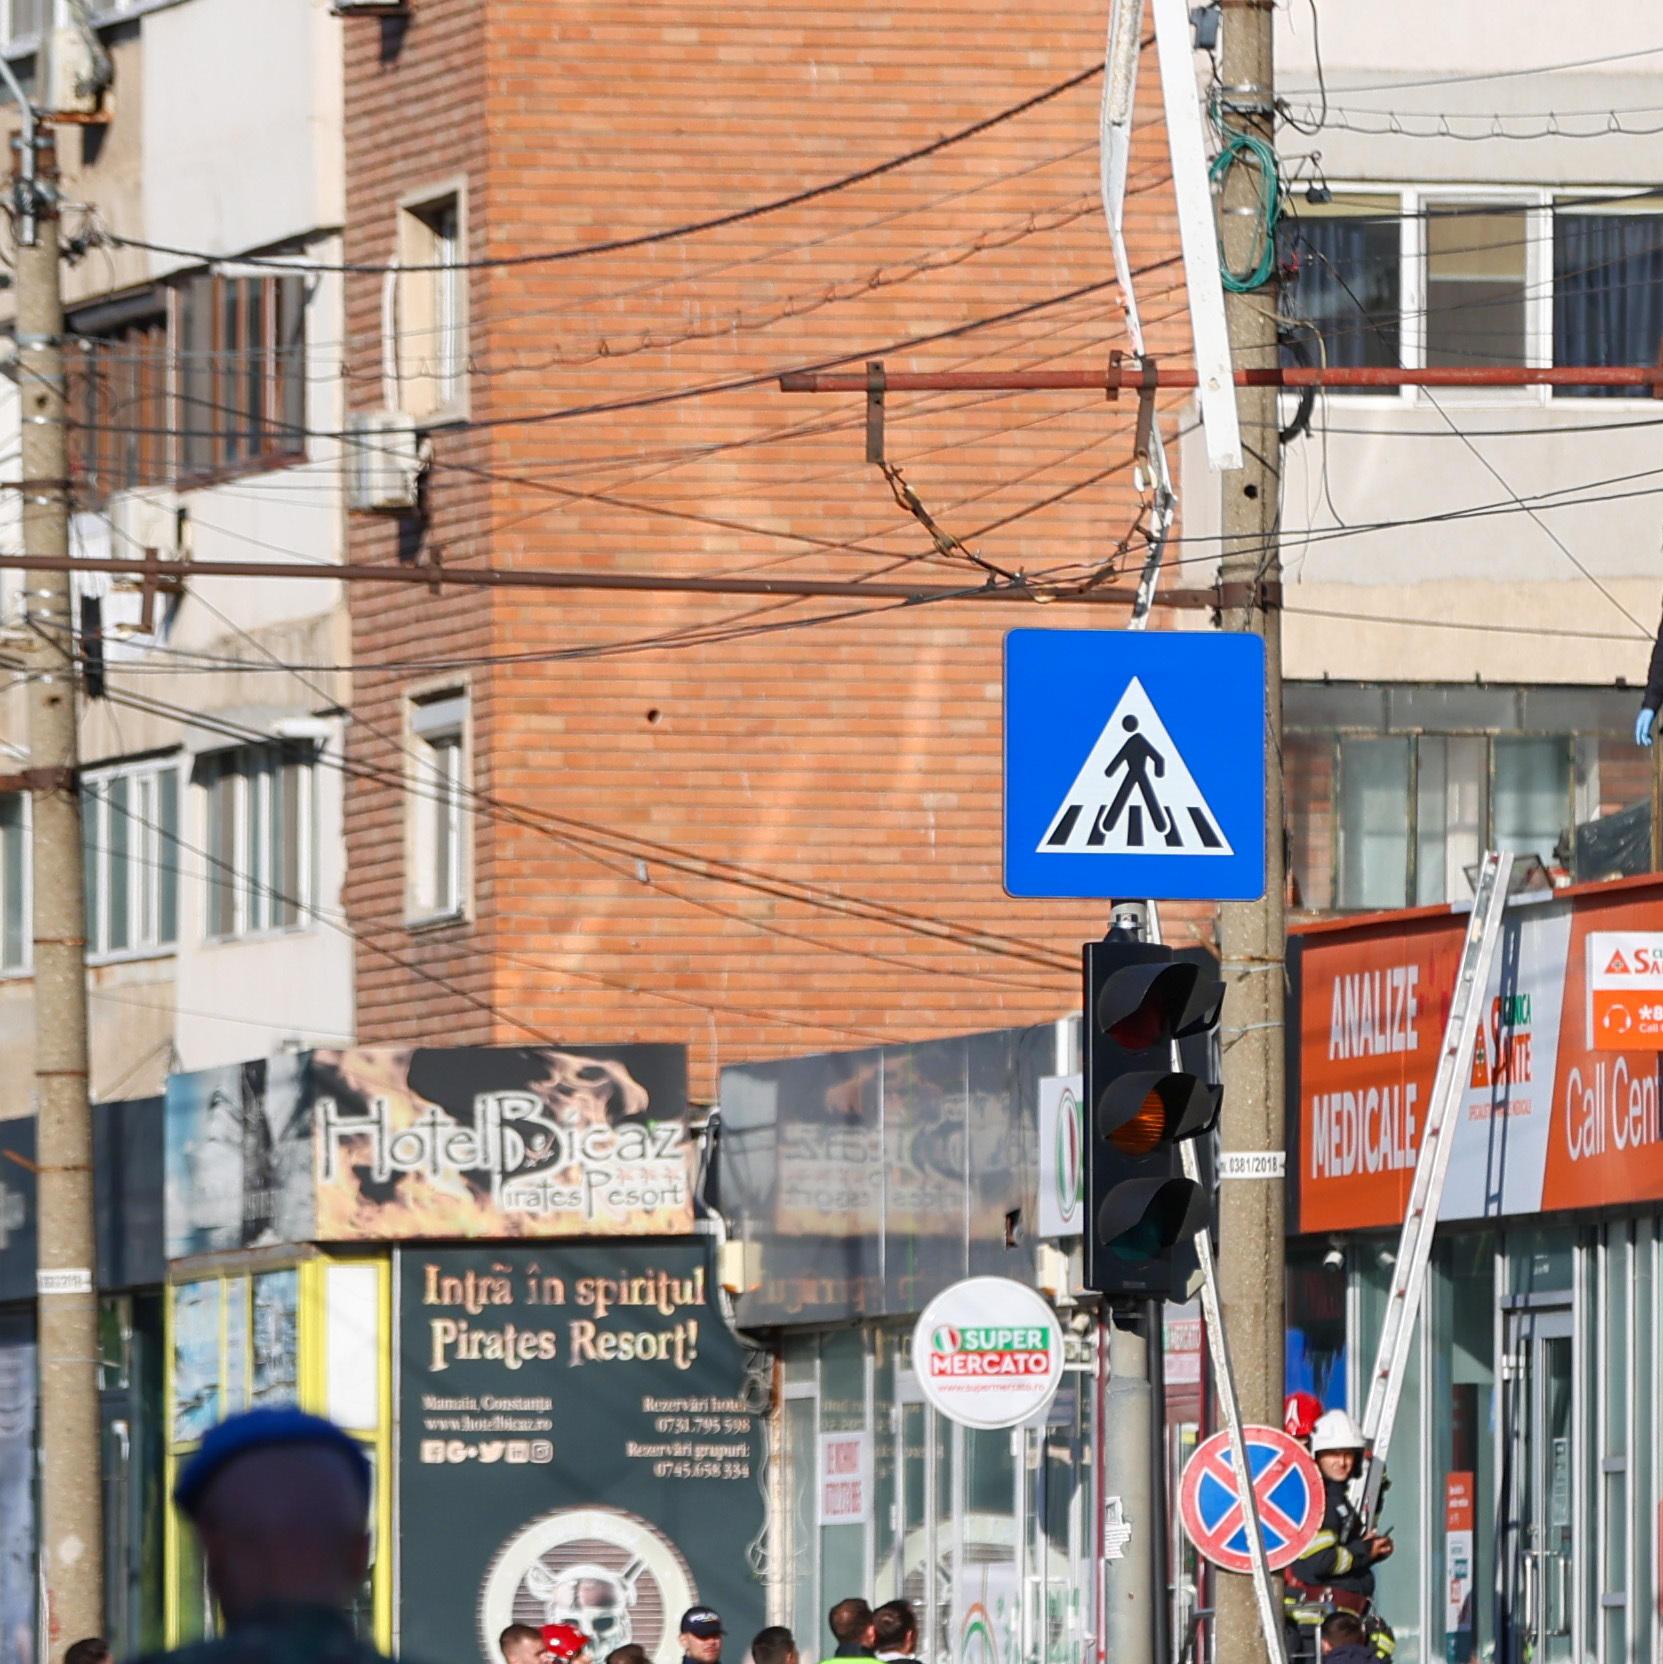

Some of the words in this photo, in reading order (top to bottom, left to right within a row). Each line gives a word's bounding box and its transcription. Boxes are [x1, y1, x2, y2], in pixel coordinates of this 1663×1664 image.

[1329, 965, 1419, 1061] ANALIZE
[1638, 1023, 1658, 1034] Call
[1312, 1083, 1417, 1180] MEDICALE
[1567, 1062, 1606, 1162] Call
[322, 1098, 493, 1184] Hotel
[492, 1095, 682, 1188] Bicaz
[527, 1263, 566, 1305] în
[429, 1317, 557, 1372] Pirates
[568, 1317, 698, 1370] Resort!
[932, 1354, 1047, 1375] MERCATO
[964, 1329, 1043, 1350] SUPER
